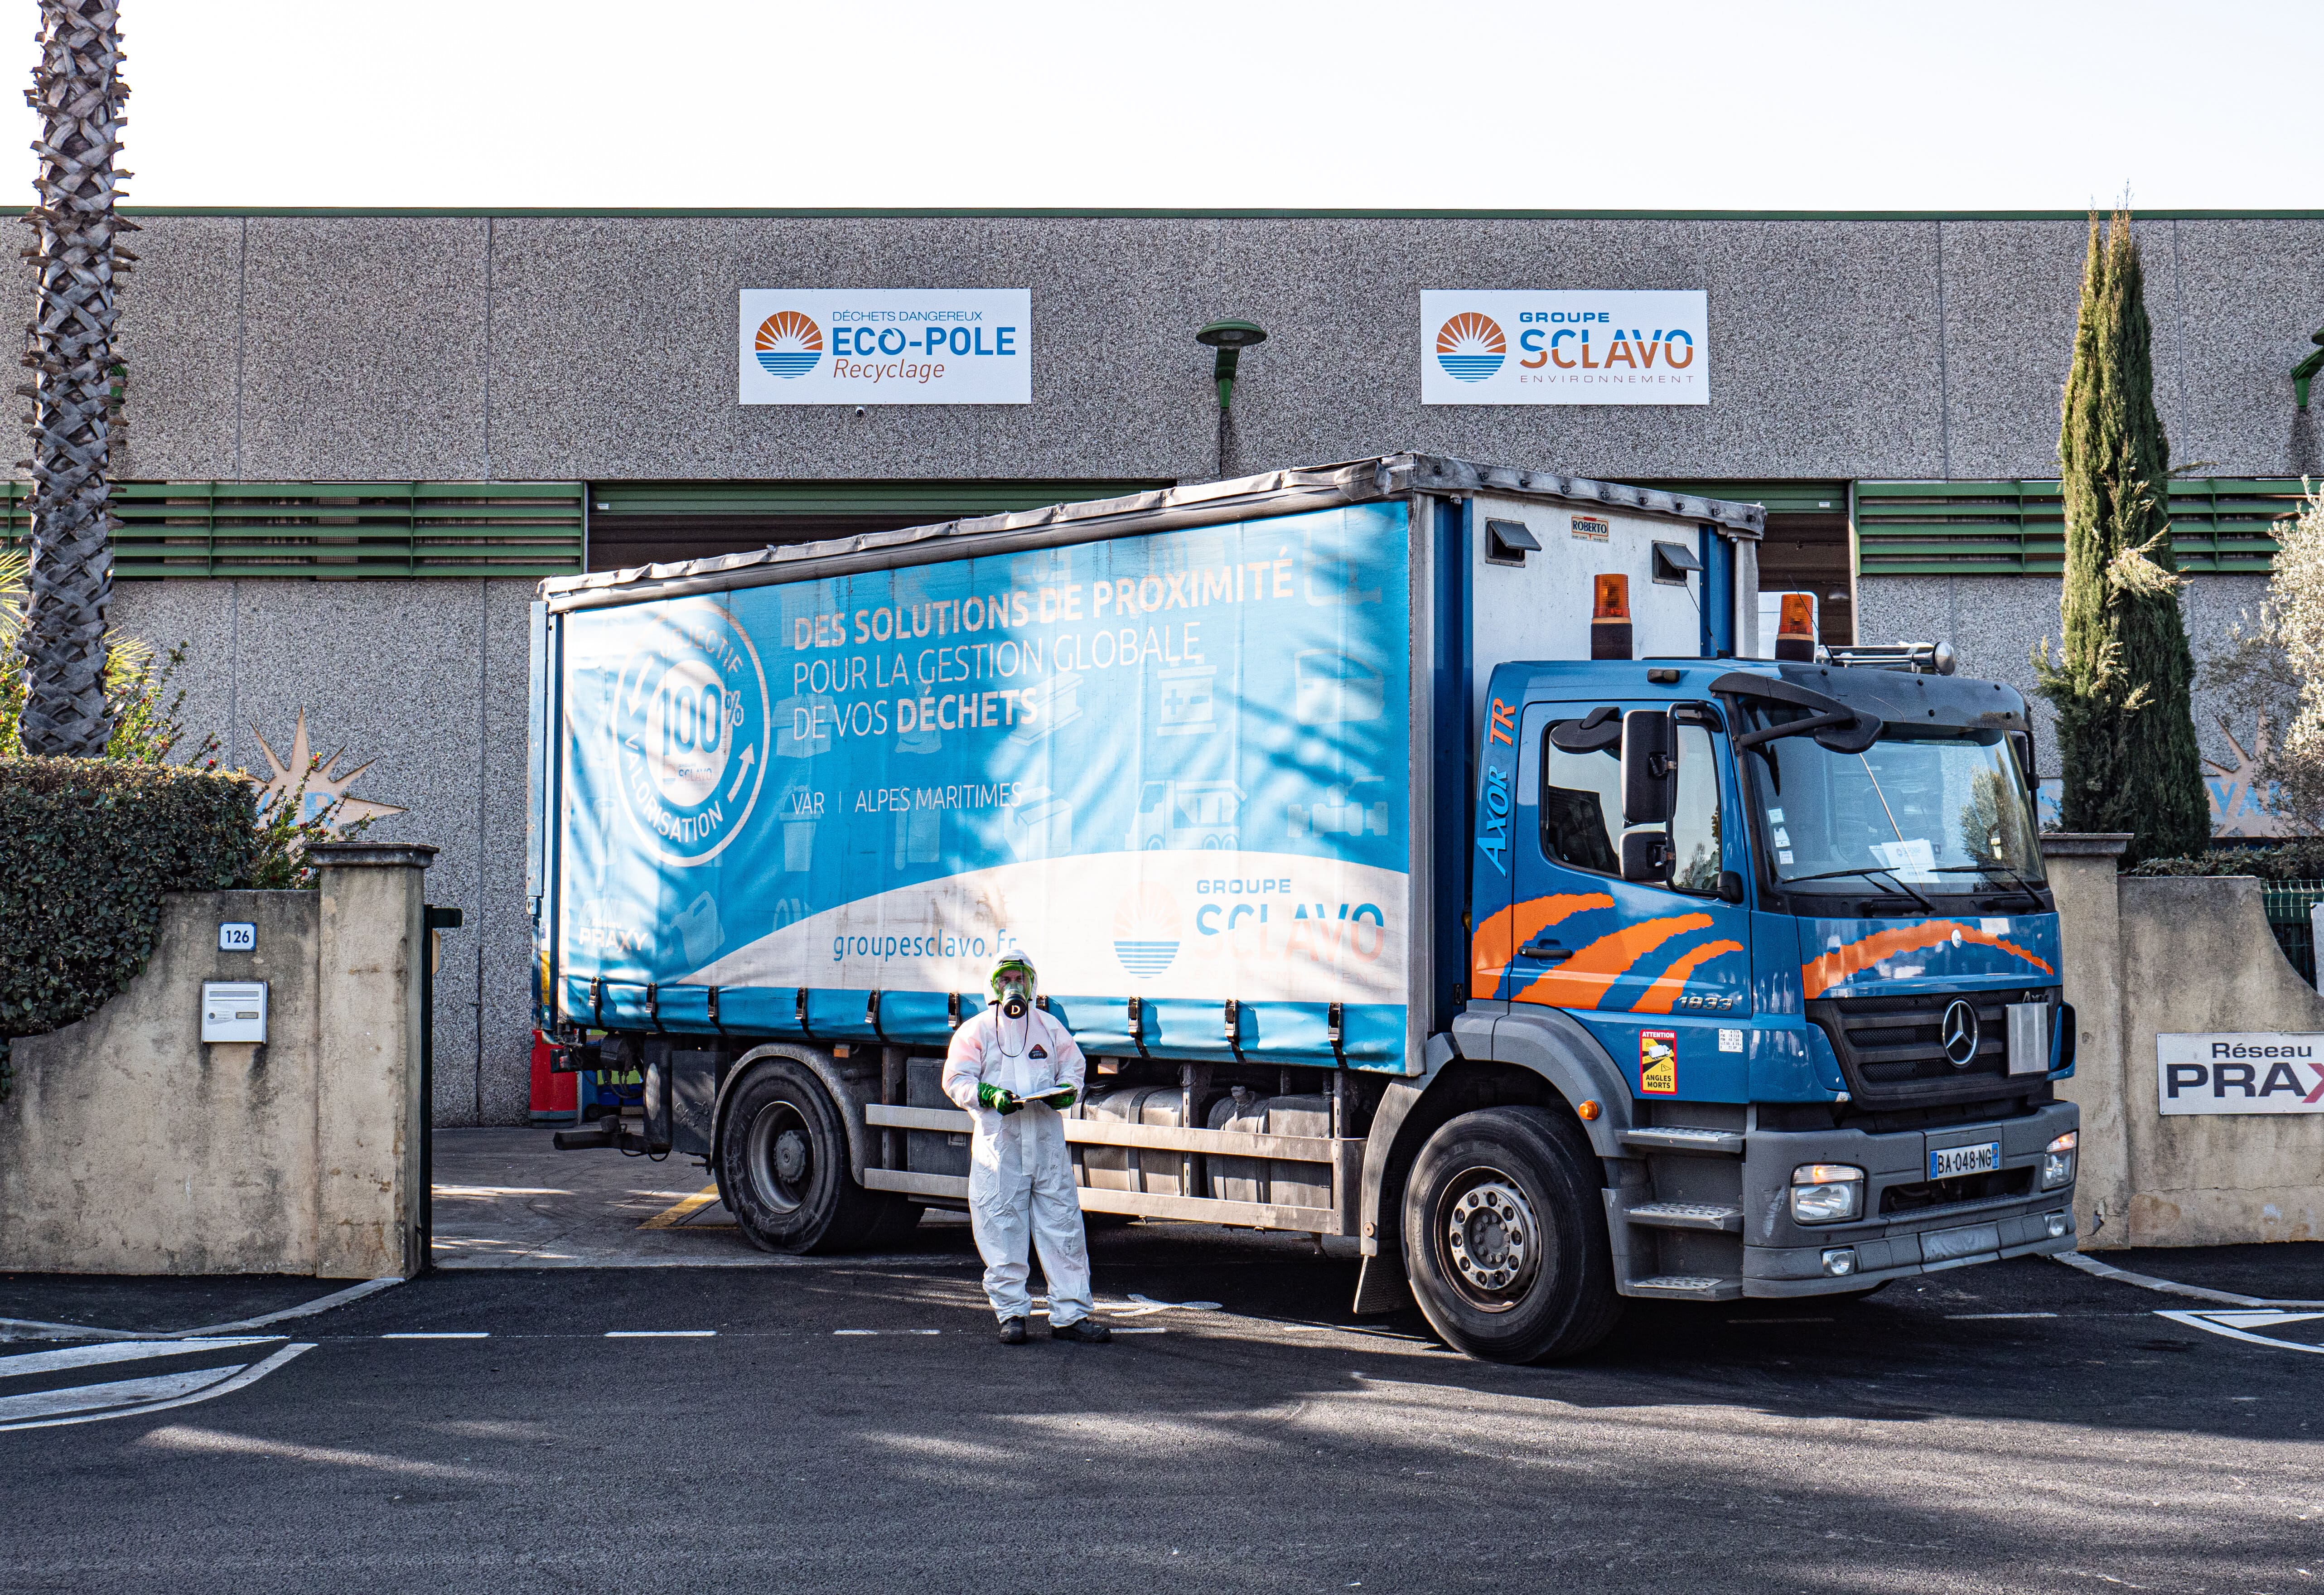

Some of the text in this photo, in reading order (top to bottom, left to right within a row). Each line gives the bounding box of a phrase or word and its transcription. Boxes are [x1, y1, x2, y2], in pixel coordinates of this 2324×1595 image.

[833, 309, 982, 321] DÉCHETS DANGEREUX
[1520, 312, 1609, 323] GROUPE
[832, 327, 1015, 356] ECO-POLE
[1520, 329, 1693, 369] SCLAVO
[834, 358, 944, 383] Recyclage
[1573, 520, 1607, 533] ROBERTO
[794, 548, 1293, 650] DES SOLUTIONS DE PROXIMITÉ
[795, 622, 1201, 694] POUR LA GESTION GLOBALE
[793, 686, 1037, 740] DE VOS DÉCHETS
[1489, 698, 1516, 746] TR
[625, 733, 723, 843] VALORISATION
[792, 782, 1022, 815] VAR ALPES MARITIMES
[1196, 879, 1291, 894] GROUPE
[227, 930, 249, 943] 126
[579, 927, 648, 953] PRAXY
[834, 928, 1016, 962] groupesclavo.fr
[1195, 903, 1384, 962] SCLAVO
[1678, 996, 1733, 1010] 1833
[2212, 1043, 2311, 1058] Réseau
[1938, 1148, 1991, 1174] BA-048-NG
